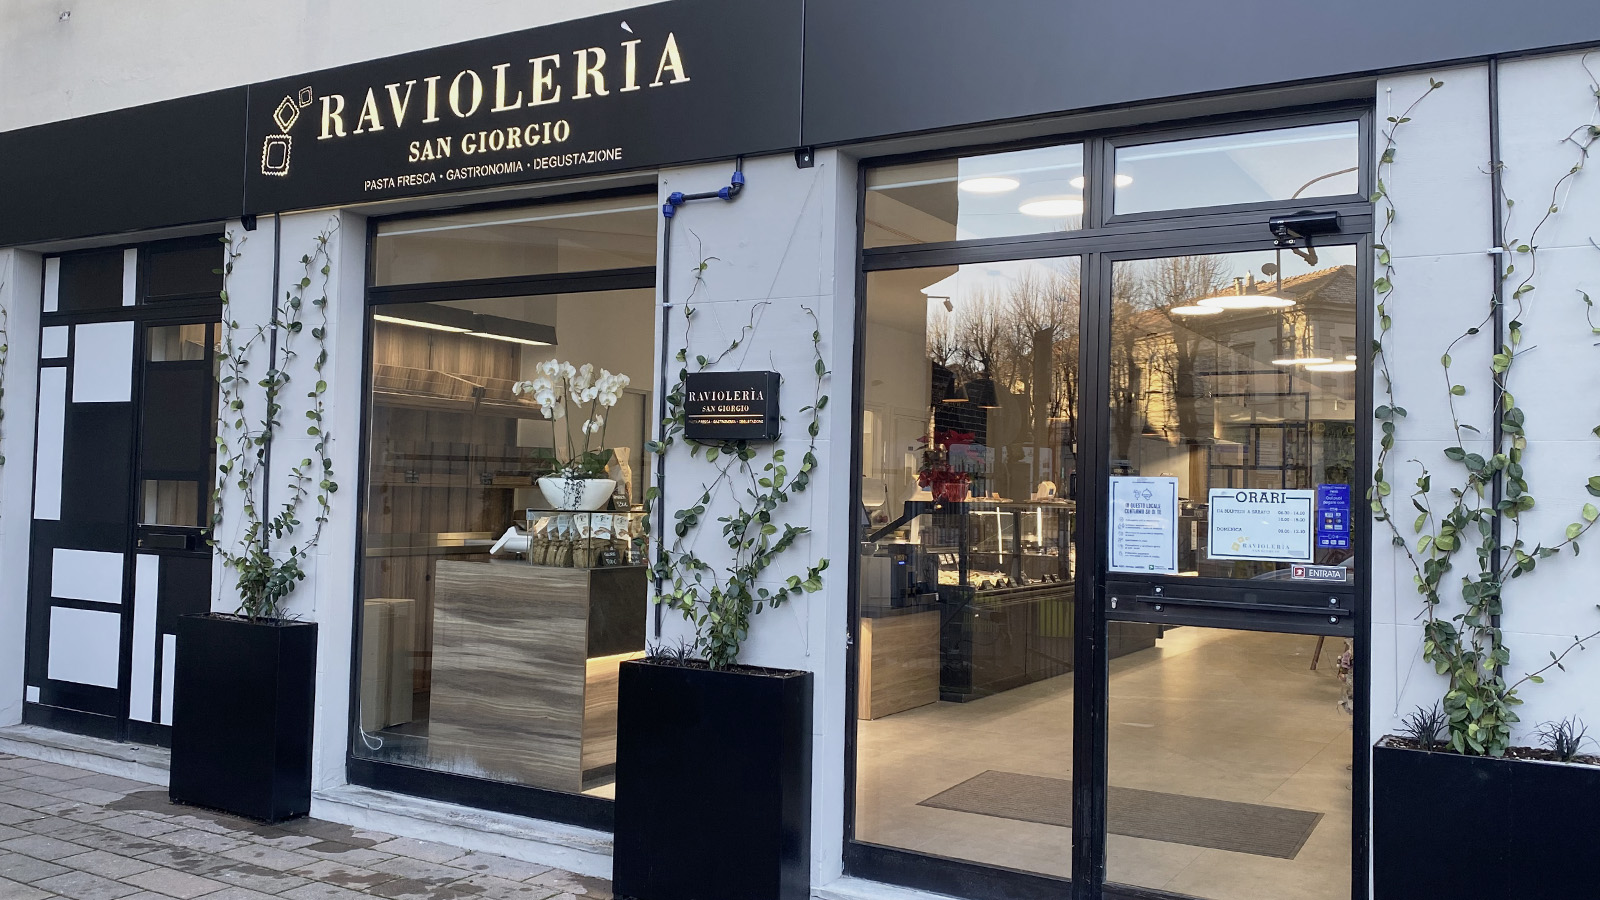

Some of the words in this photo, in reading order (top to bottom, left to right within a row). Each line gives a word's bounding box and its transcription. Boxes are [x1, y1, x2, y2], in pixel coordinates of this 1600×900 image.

[317, 21, 690, 140] RAVIOLERÌA
[408, 137, 452, 163] SAN
[461, 120, 570, 155] GIORGIO
[364, 177, 395, 191] PASTA
[397, 173, 437, 187] FRESCA
[446, 161, 523, 181] GASTRONOMIA
[533, 147, 623, 170] DEGUSTAZIONE
[688, 387, 764, 401] RAVIOLERÌA
[717, 404, 749, 412] GIORGIO
[1235, 491, 1286, 504] ORARI
[1309, 569, 1341, 578] ENTRATA
